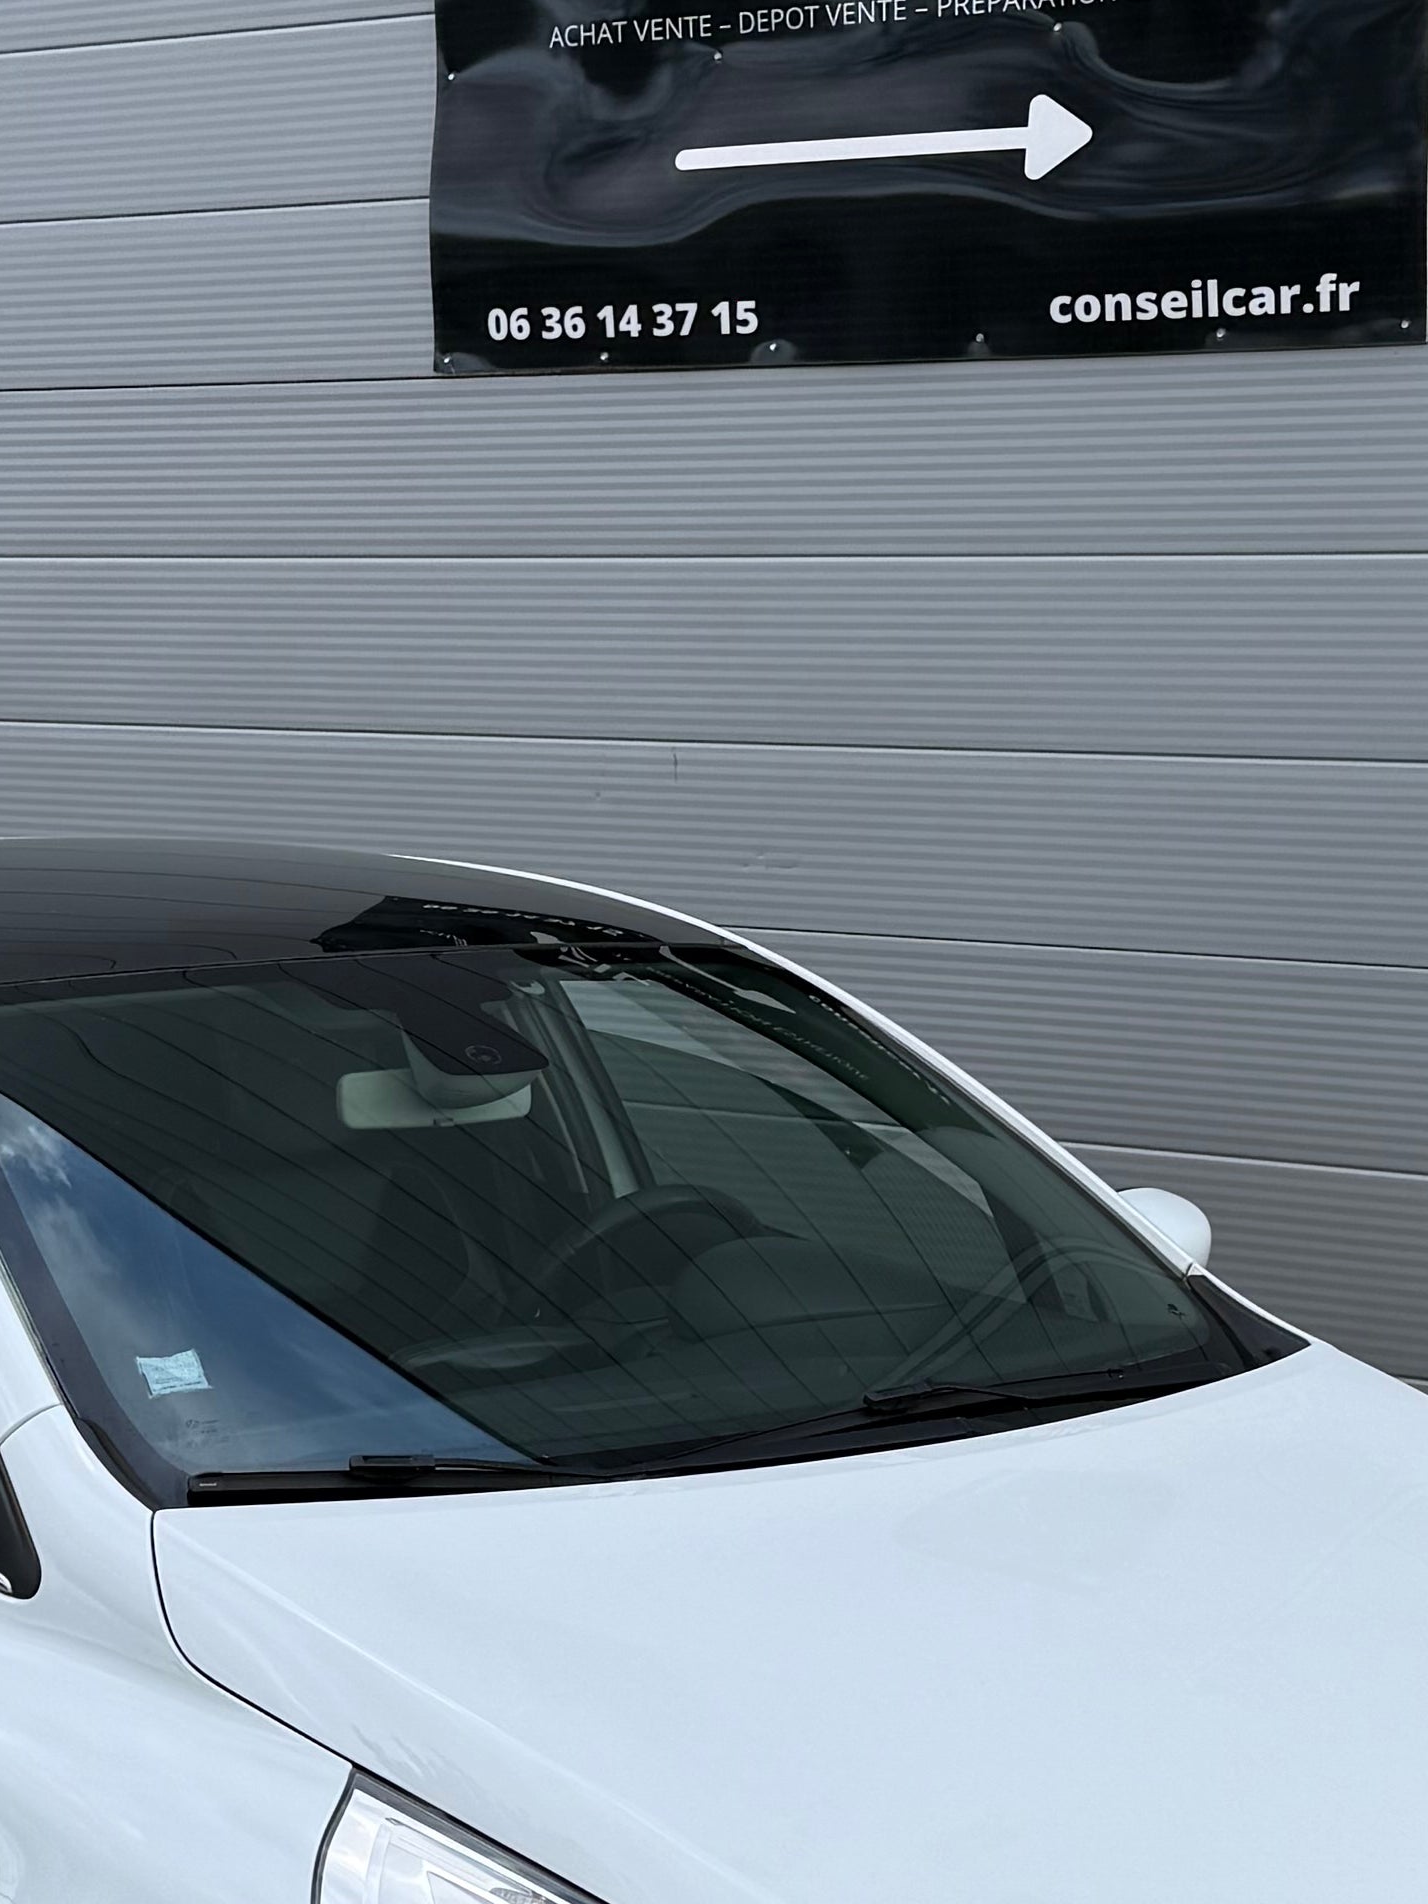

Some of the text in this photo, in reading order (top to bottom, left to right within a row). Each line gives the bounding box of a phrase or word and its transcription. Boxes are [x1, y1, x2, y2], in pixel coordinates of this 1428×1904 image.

[549, 20, 628, 49] ACHAT
[633, 14, 712, 42] VENTE
[739, 5, 820, 34] DEPOT
[1049, 272, 1360, 324] conseilcar.fr
[487, 300, 759, 341] 06 36 14 37 15
